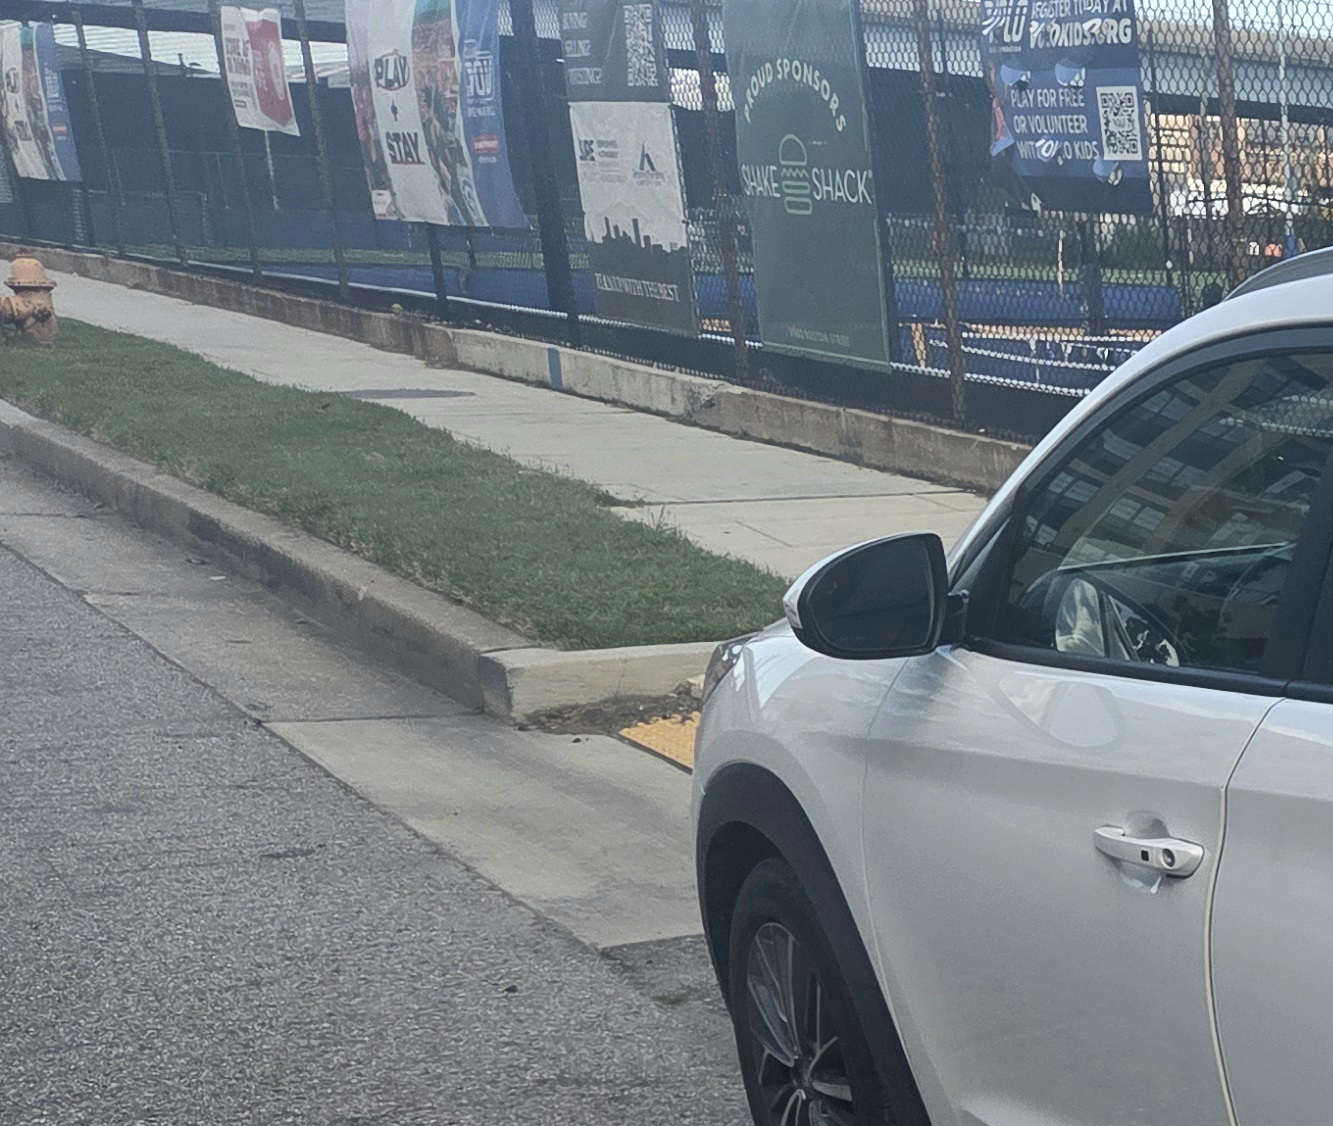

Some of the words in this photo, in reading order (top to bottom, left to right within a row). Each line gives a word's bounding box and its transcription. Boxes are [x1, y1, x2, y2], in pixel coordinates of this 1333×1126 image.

[374, 55, 408, 89] PLAY
[744, 62, 774, 124] PROUD
[776, 58, 847, 132] SPONSORS
[1011, 88, 1036, 109] PLAY
[1036, 88, 1058, 108] FOR
[1059, 88, 1086, 107] FREE
[1013, 115, 1028, 134] OR
[1028, 115, 1089, 134] VOLUNTEER
[386, 131, 422, 164] STAY
[1073, 141, 1101, 160] KIDS
[741, 164, 781, 198] SHAKE
[812, 167, 872, 205] SHACK
